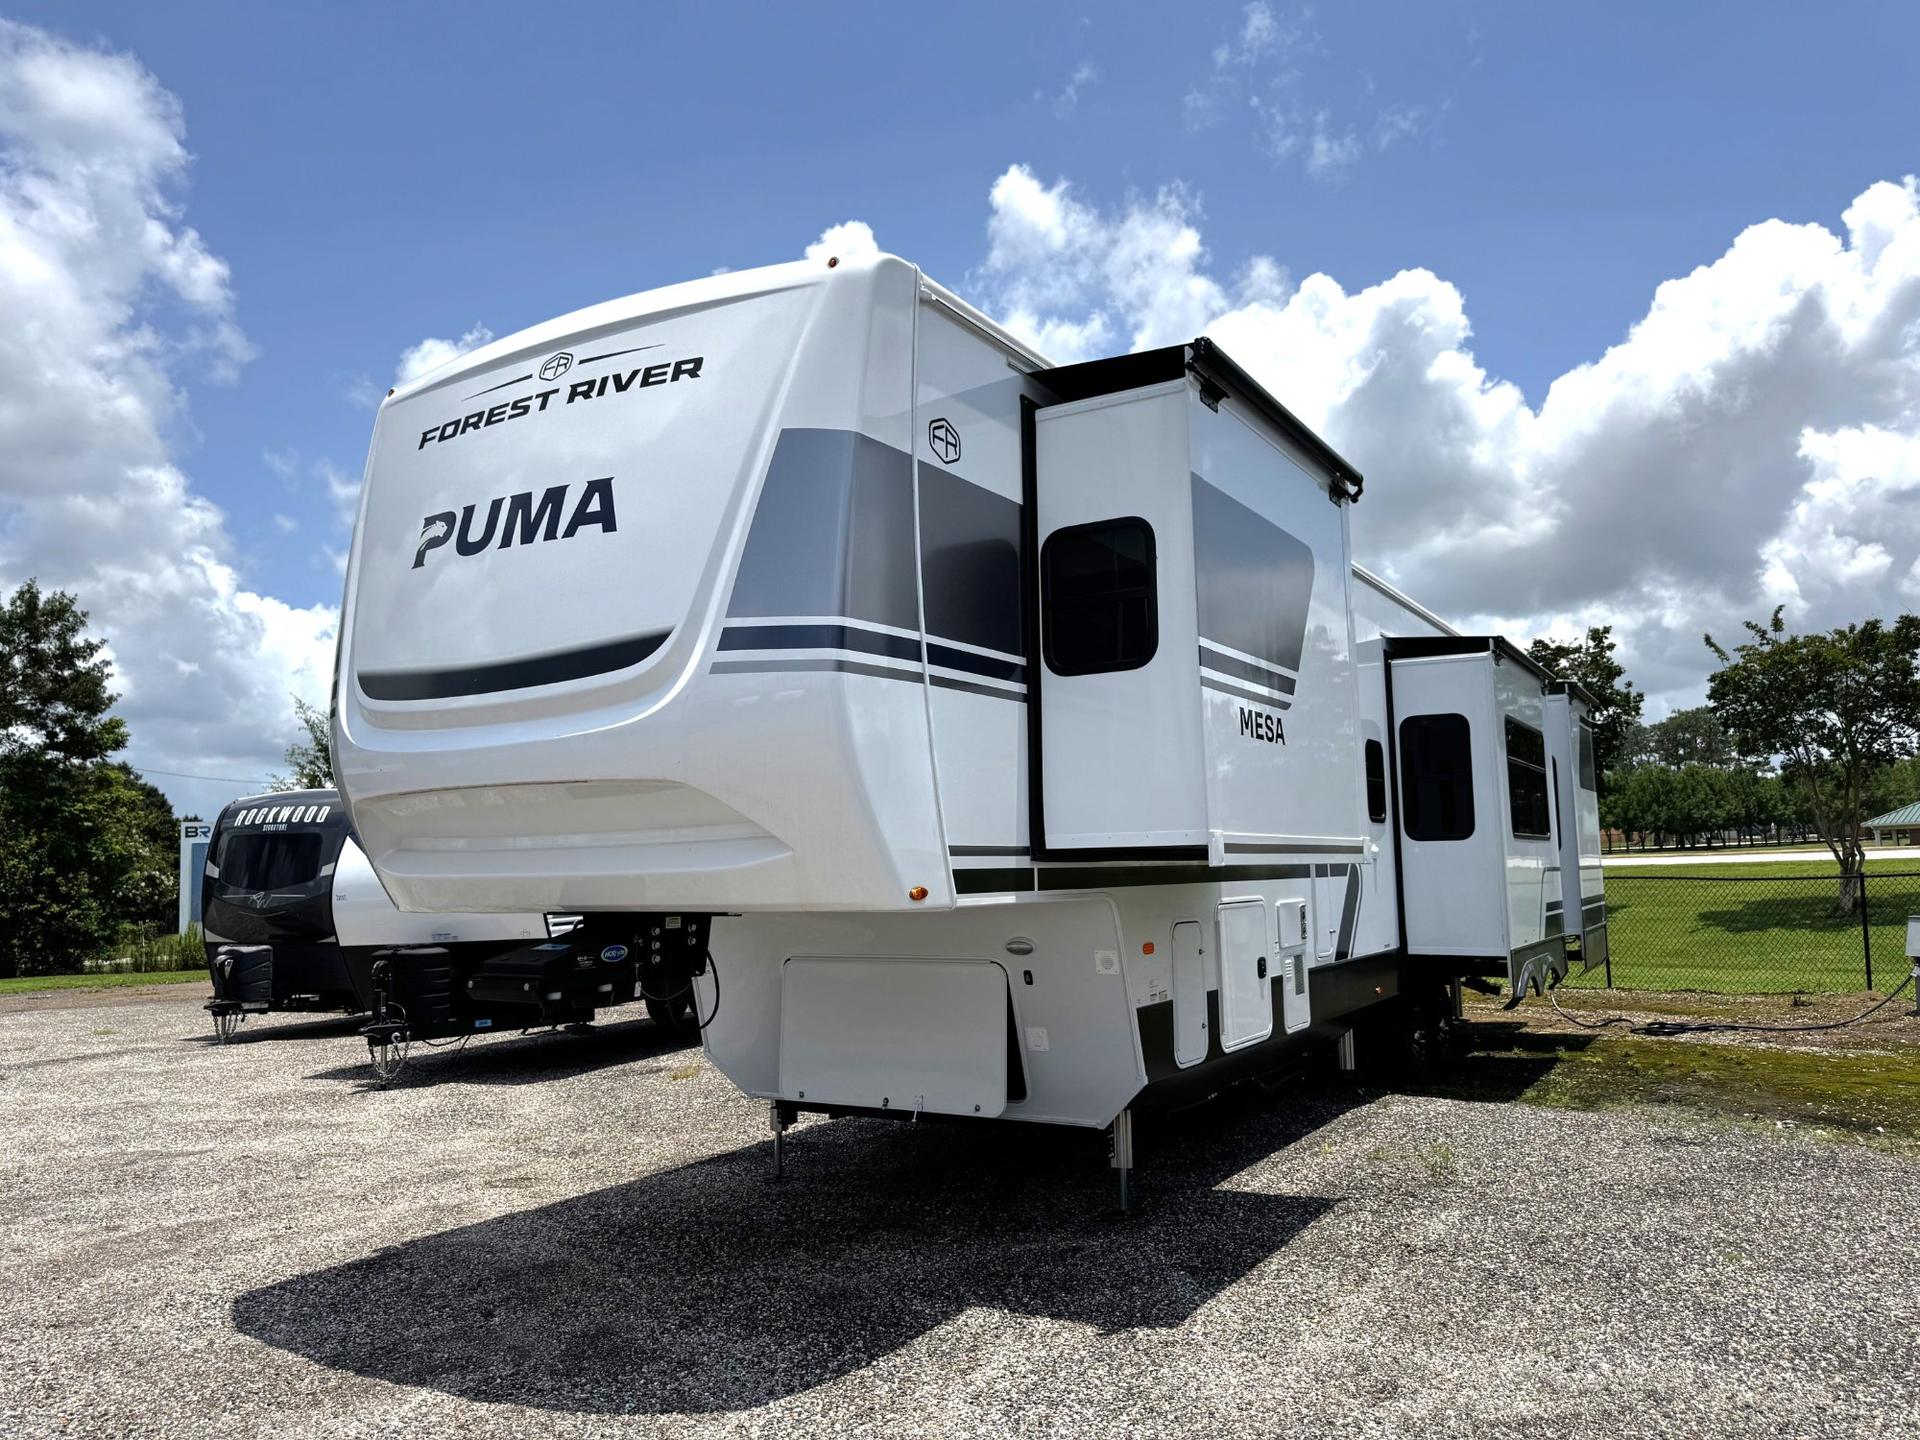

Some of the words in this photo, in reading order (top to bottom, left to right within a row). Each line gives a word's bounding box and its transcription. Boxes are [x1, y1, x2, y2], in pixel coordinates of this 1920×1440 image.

[418, 388, 560, 450] FOREST
[566, 356, 704, 404] RIVER
[411, 476, 617, 569] PUMA
[1239, 706, 1286, 746] MESA
[234, 806, 331, 827] ROCKWOOD
